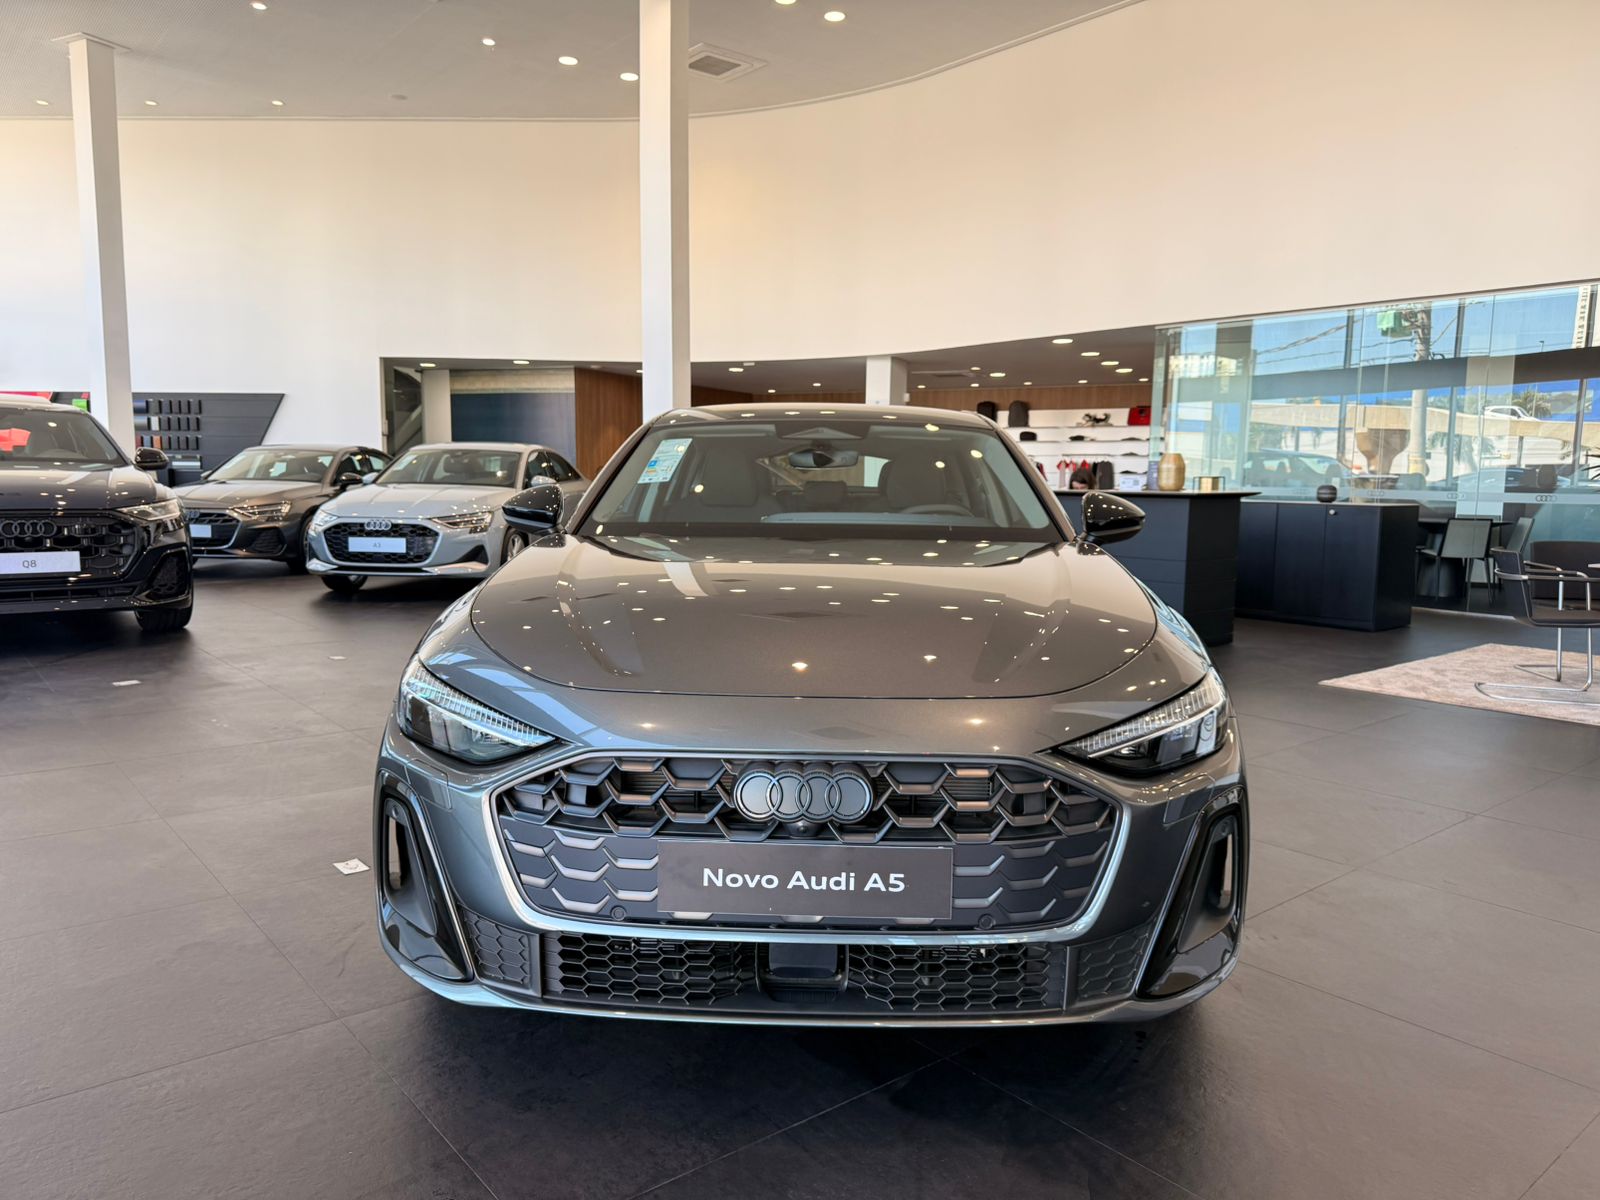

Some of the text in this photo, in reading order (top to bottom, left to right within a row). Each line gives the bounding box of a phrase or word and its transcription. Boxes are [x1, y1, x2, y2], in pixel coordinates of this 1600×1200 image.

[22, 559, 37, 568] Q8
[702, 867, 906, 893] Novo Audi A5
